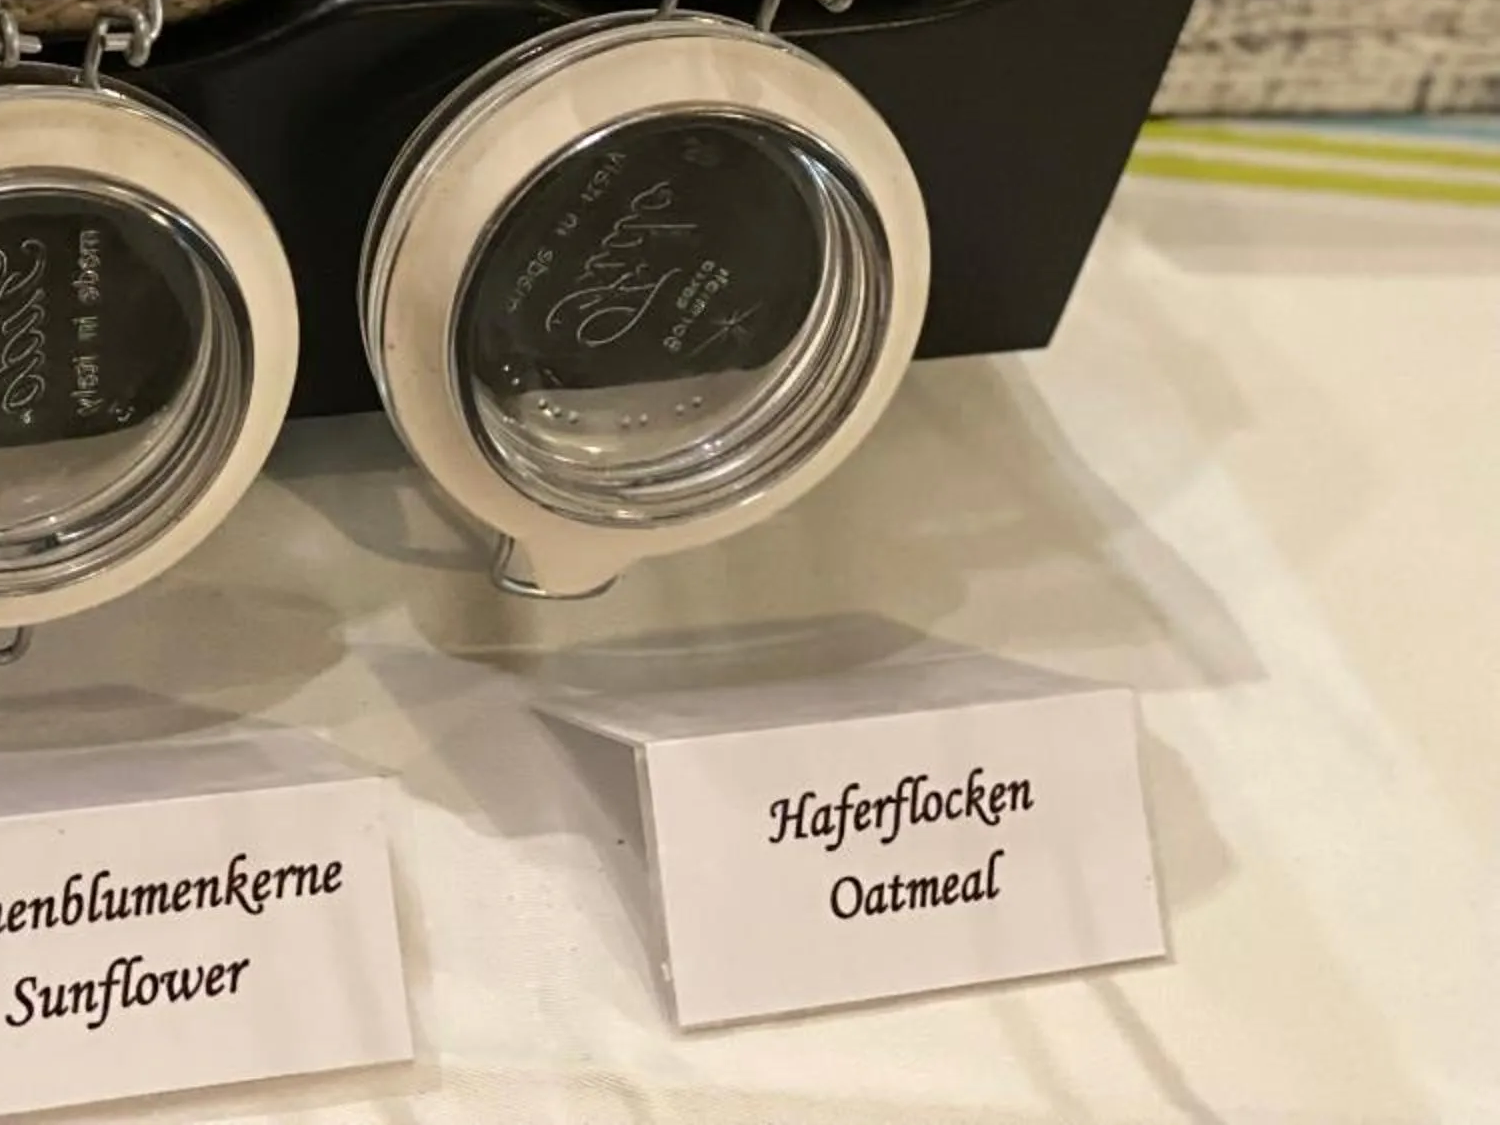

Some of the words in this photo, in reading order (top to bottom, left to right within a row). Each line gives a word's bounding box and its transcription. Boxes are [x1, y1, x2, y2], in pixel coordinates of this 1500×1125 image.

[769, 767, 1034, 852] Haferflocken
[825, 849, 1005, 920] Oatmeal
[5, 955, 250, 1030] Sunflower
